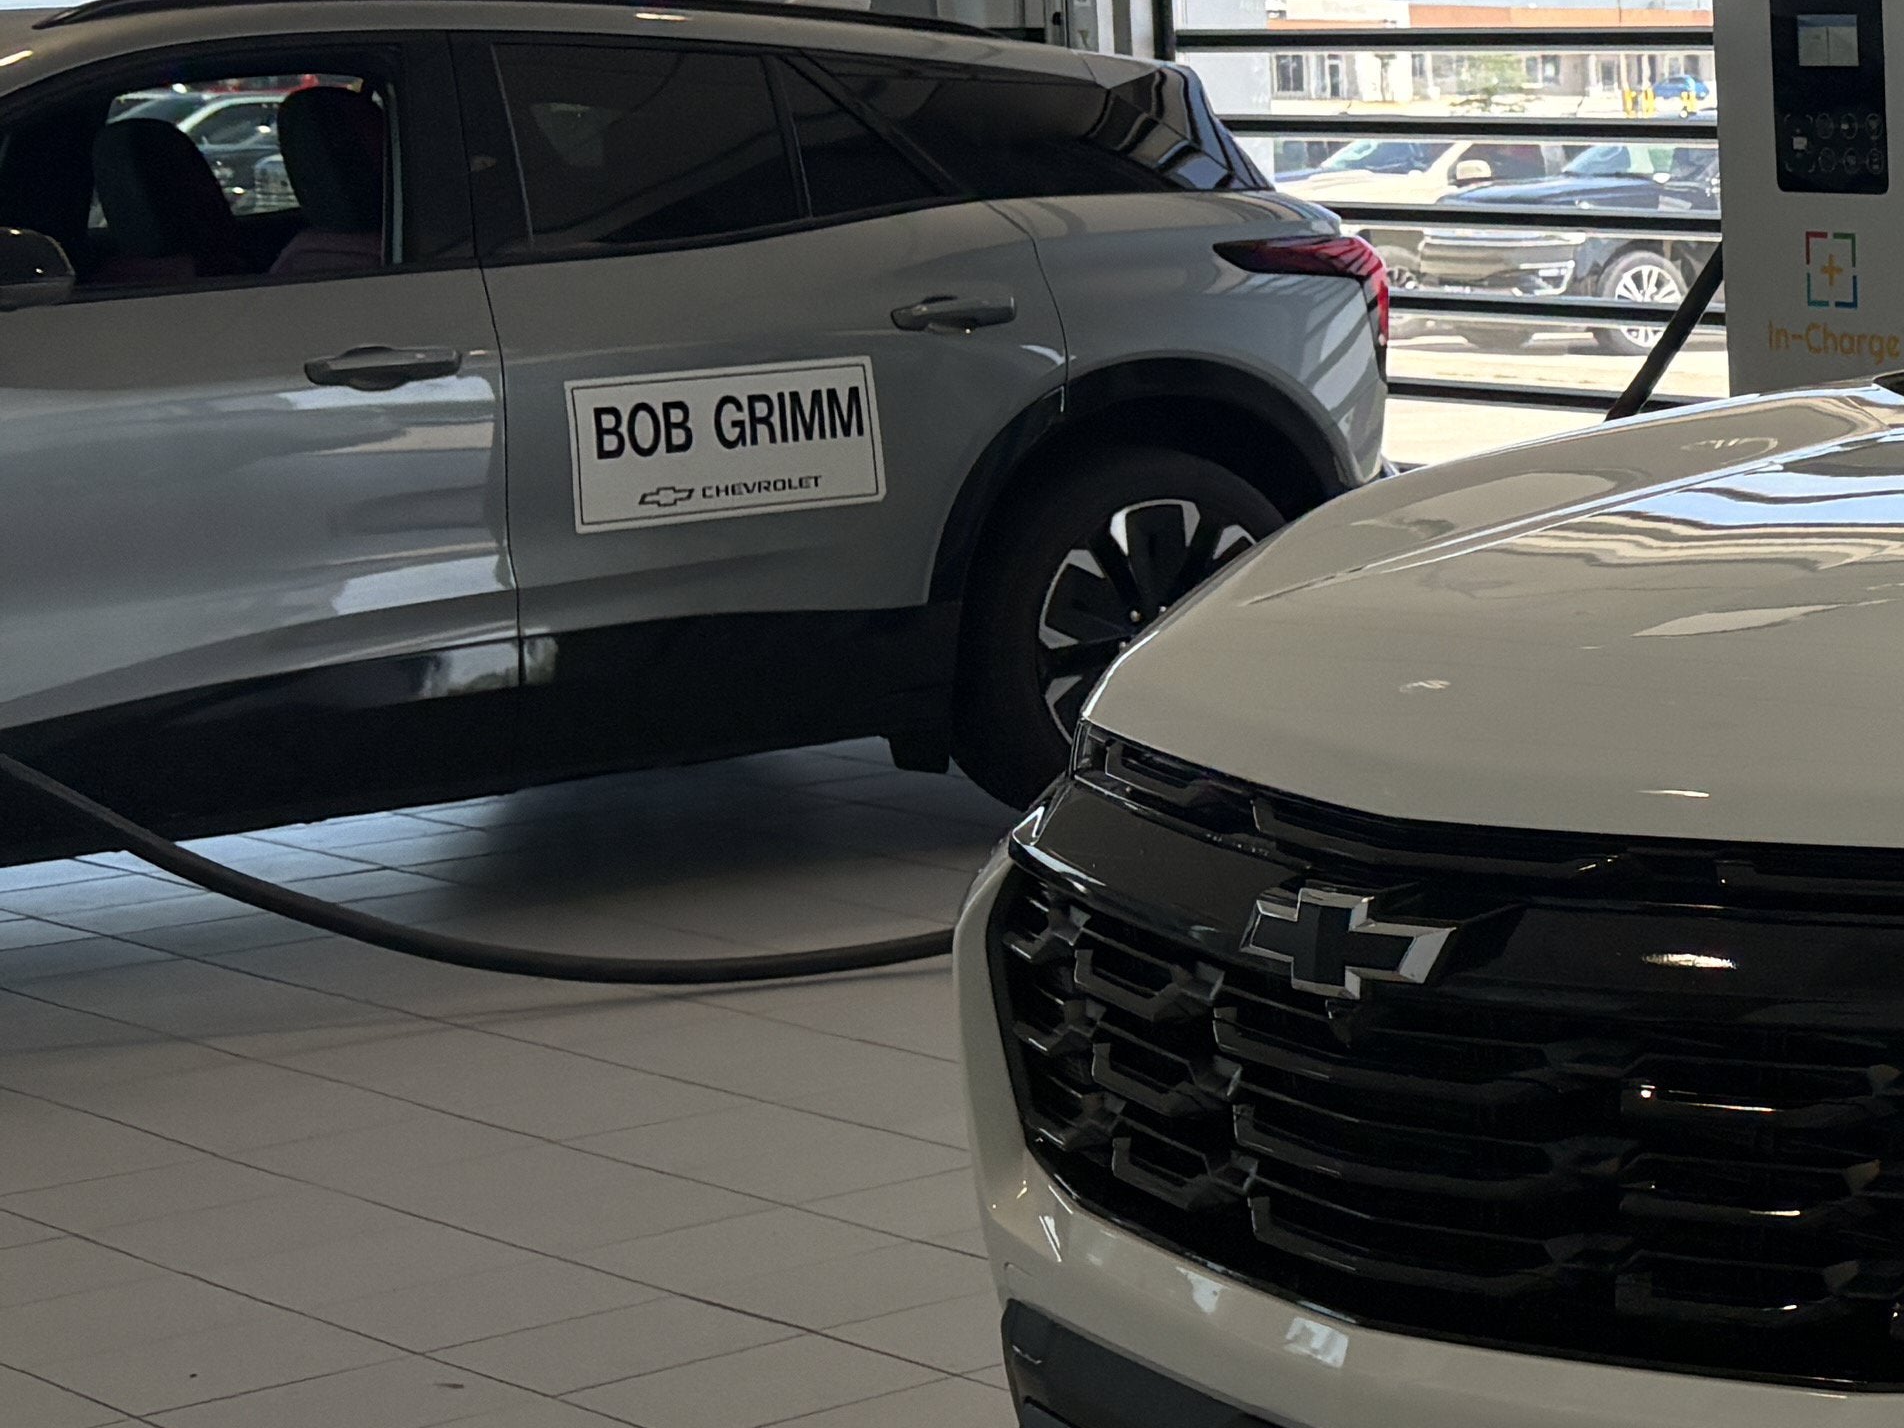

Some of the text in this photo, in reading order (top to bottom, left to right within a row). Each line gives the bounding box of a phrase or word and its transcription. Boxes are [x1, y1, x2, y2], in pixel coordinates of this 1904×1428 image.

[1768, 321, 1900, 365] In-Charge
[593, 386, 865, 460] BOB GRIMM
[702, 475, 822, 499] CHEVROLET
